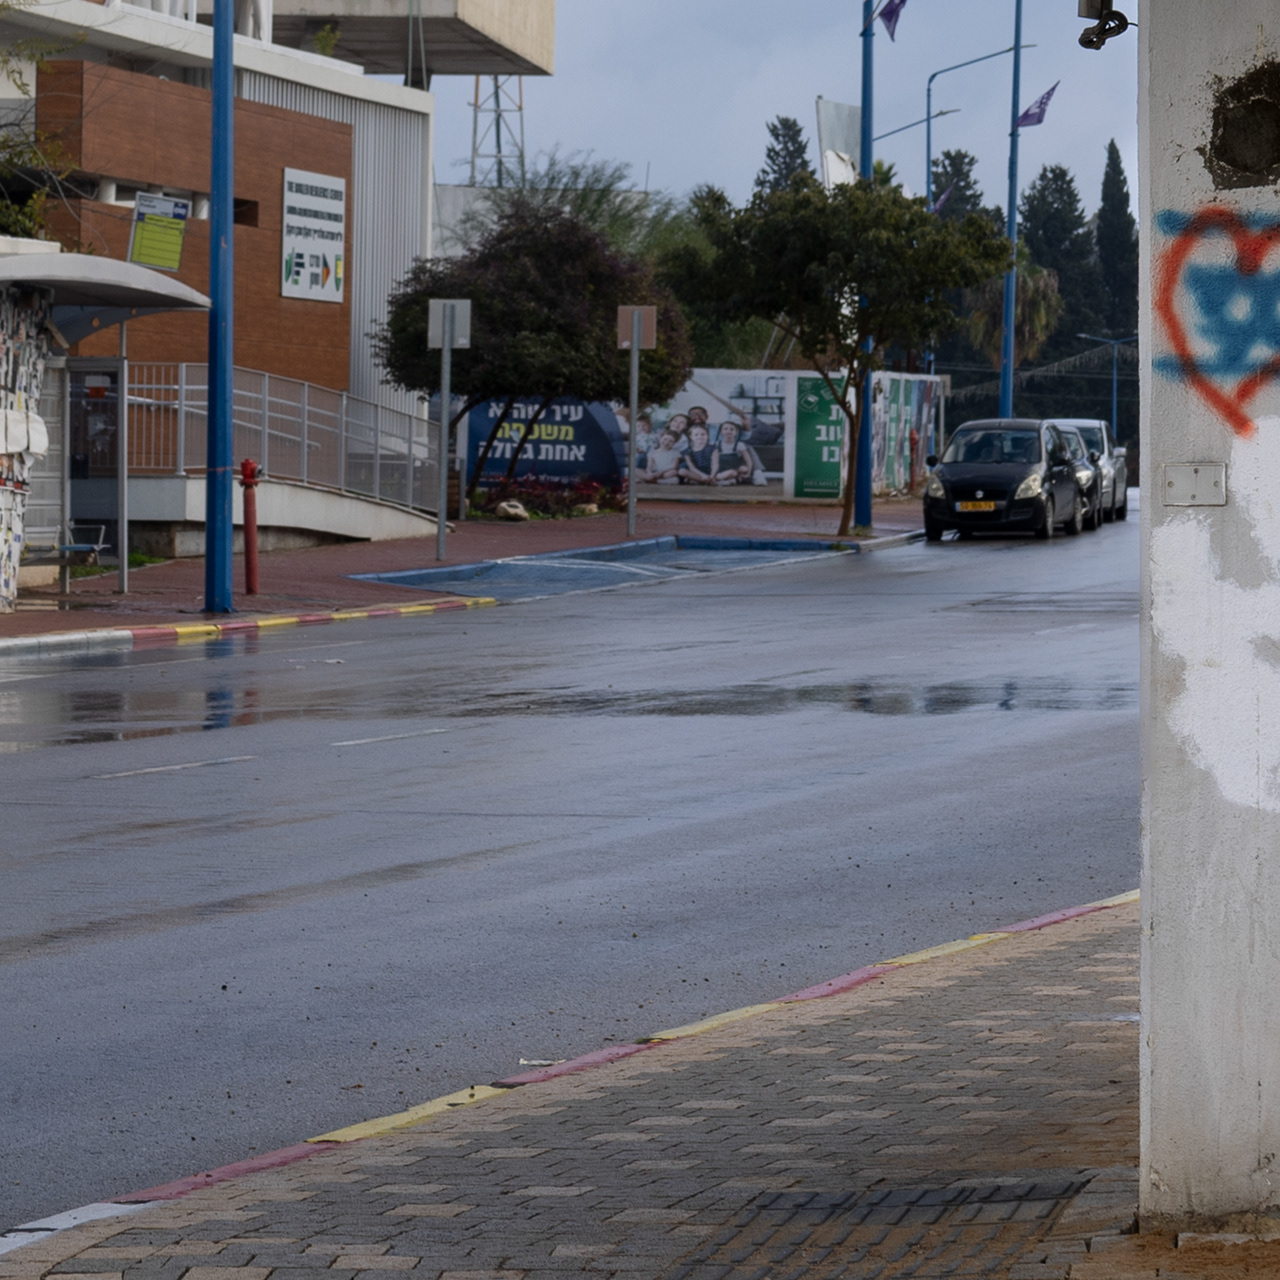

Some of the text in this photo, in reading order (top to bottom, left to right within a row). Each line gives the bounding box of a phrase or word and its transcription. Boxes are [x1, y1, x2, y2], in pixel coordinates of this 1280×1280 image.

[488, 402, 584, 421] עיר שהא
[537, 443, 586, 461] אחת
